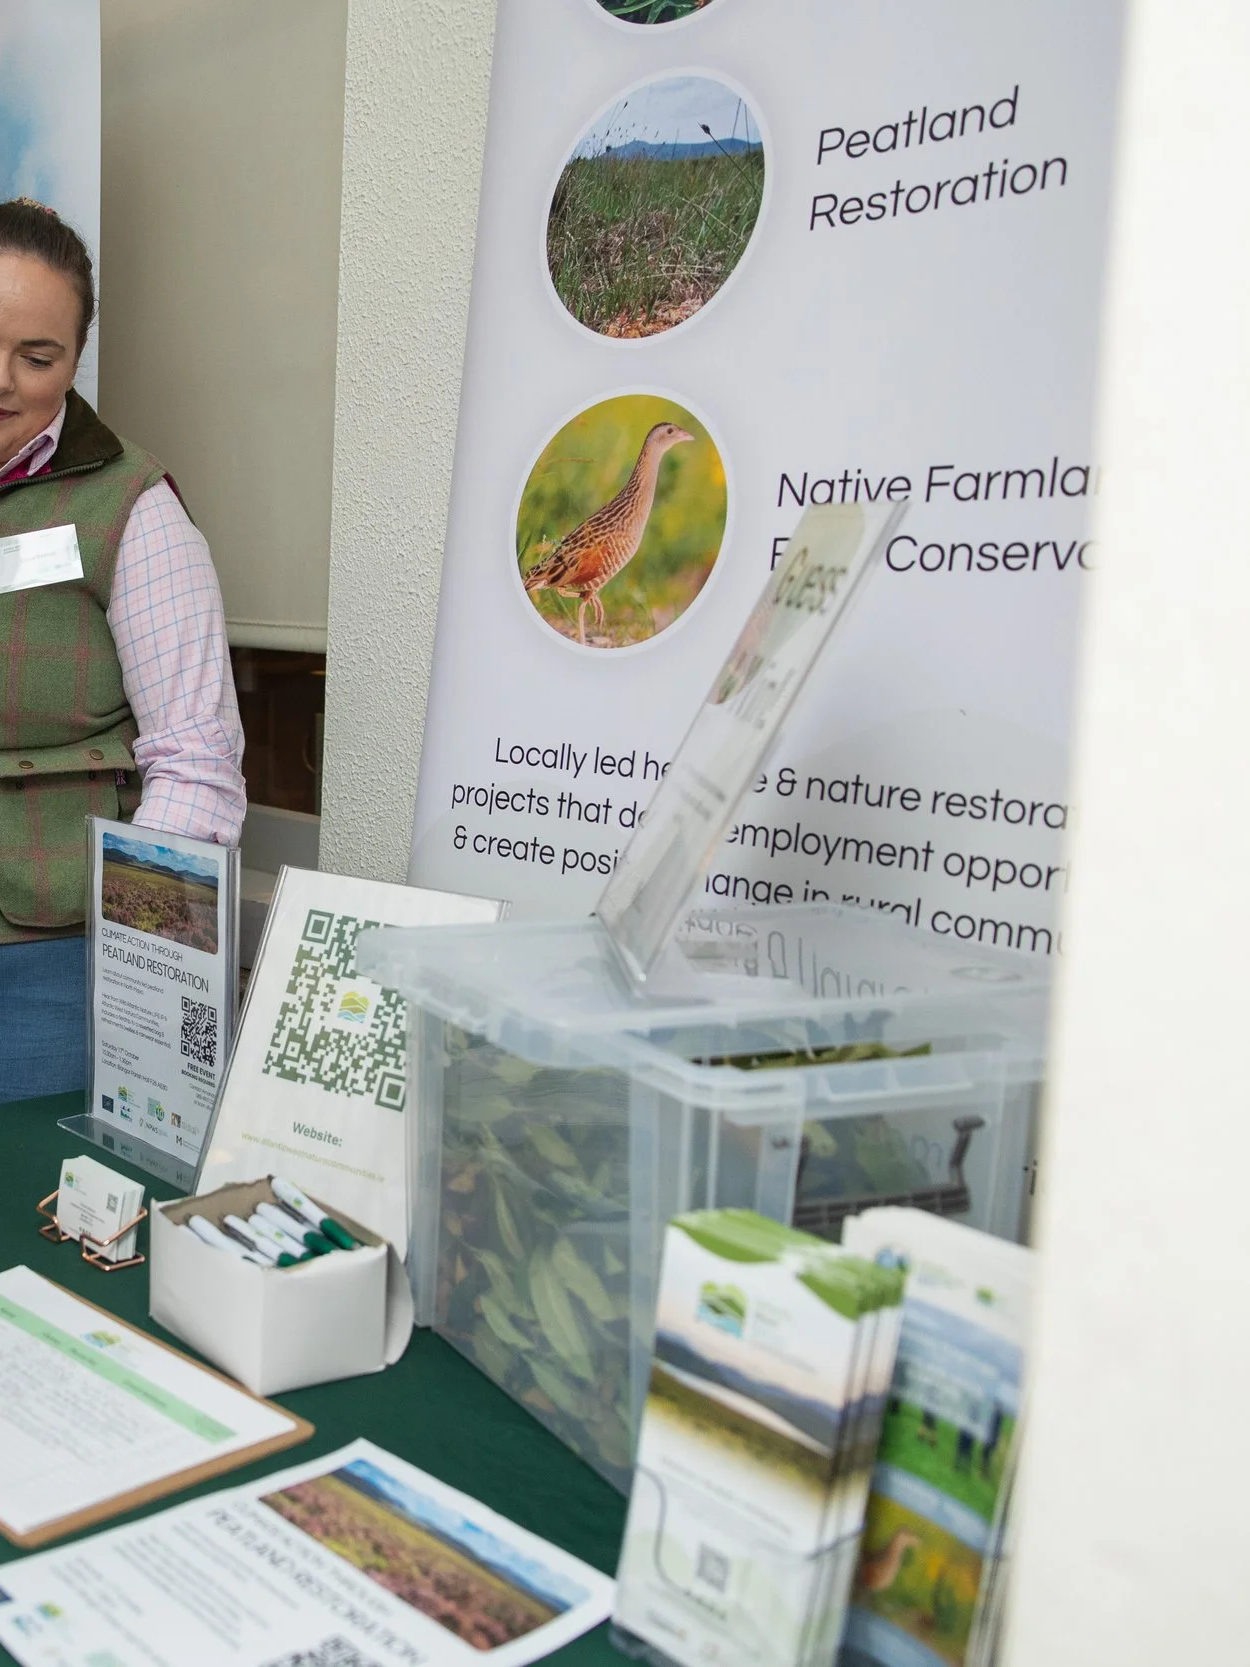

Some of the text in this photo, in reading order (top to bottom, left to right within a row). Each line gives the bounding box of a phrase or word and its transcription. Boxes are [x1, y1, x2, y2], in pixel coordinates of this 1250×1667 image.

[817, 85, 1019, 165] Peatland
[810, 156, 1068, 231] Restoration
[778, 456, 1096, 507] Native Farmla
[495, 737, 587, 778] Locally
[594, 746, 636, 778] led
[451, 782, 549, 815] projects
[557, 791, 613, 825] that
[776, 768, 797, 796] &
[806, 774, 921, 812] nature
[932, 788, 1069, 830] restora
[453, 825, 468, 850] &
[473, 833, 555, 865] create
[102, 928, 183, 962] CLIMATE ACTION THROUGH
[102, 944, 209, 993] PEATLAND RESTORATION
[187, 1062, 215, 1080] FREE EVENT
[292, 1121, 343, 1147] Website:
